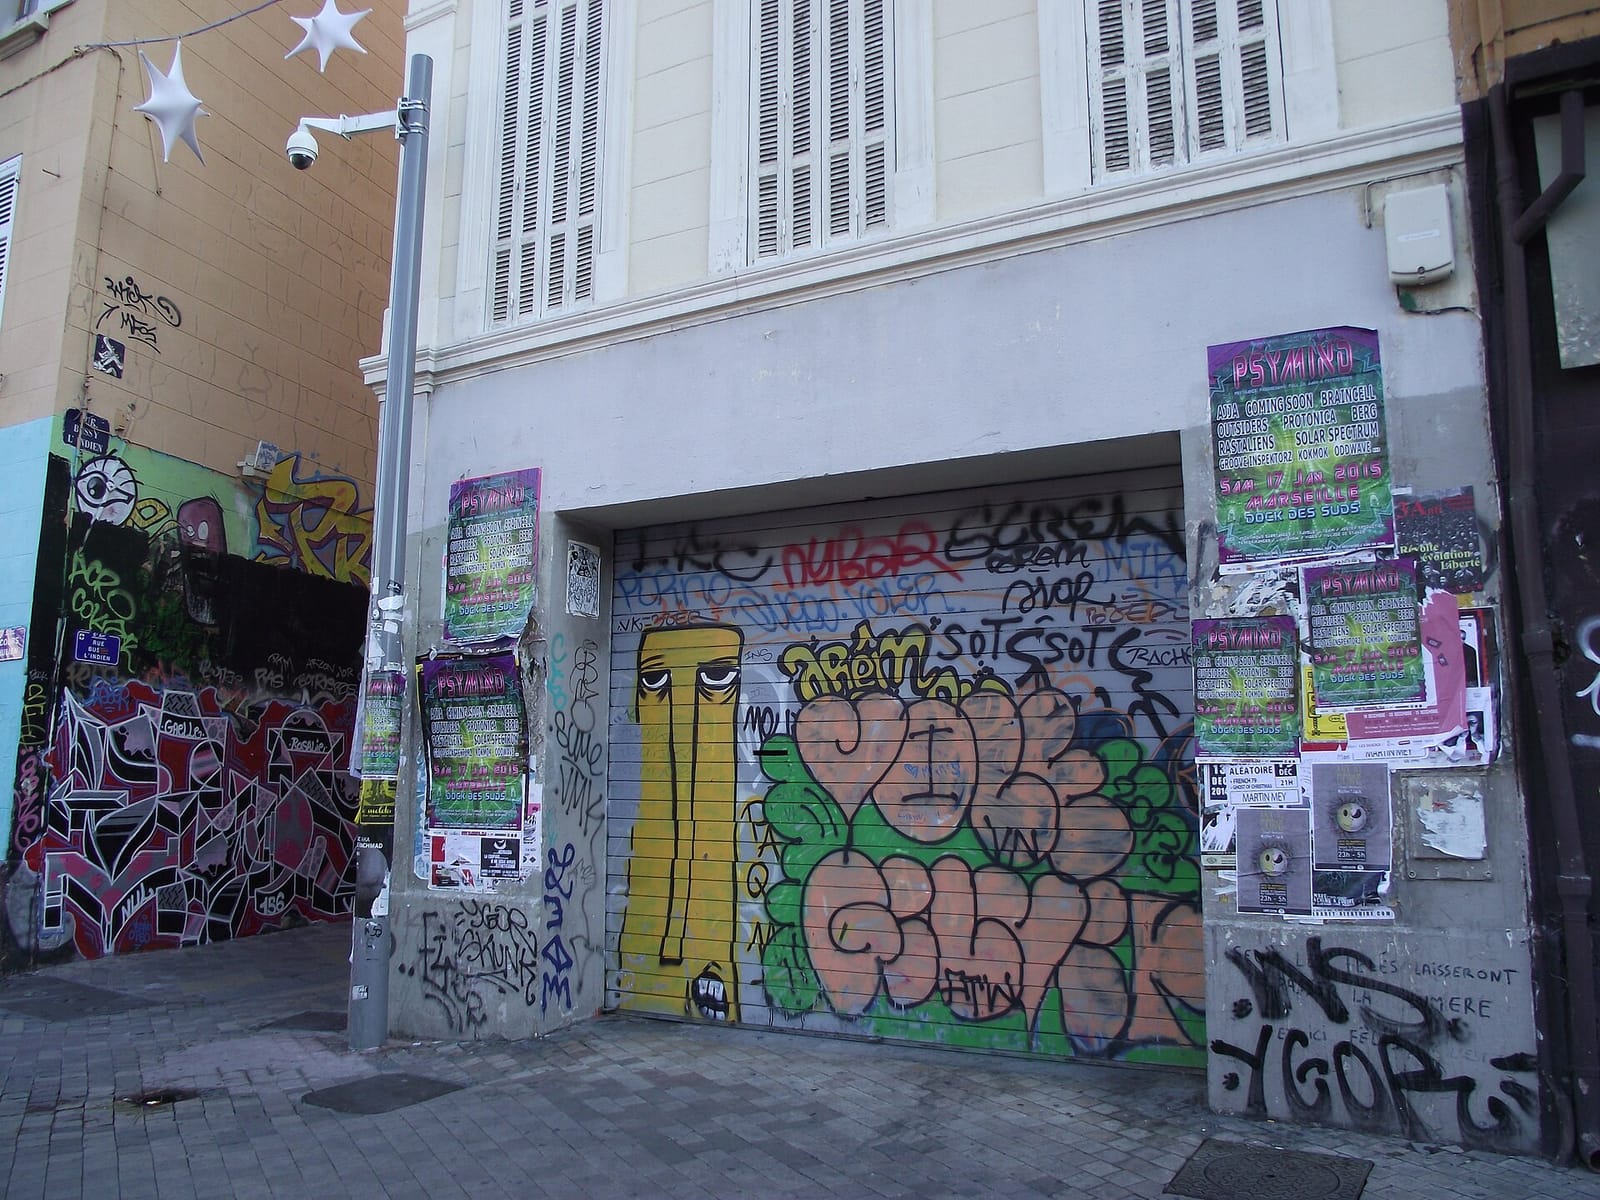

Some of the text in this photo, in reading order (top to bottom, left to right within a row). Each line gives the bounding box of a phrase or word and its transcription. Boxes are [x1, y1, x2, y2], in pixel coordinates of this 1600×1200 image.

[1232, 339, 1353, 390] PSYMIND
[1217, 402, 1239, 421] AJJA
[1321, 384, 1376, 406] BRAINCELL
[73, 423, 99, 439] BSSY
[1217, 403, 1377, 438] OUTSIDERS PROTONICA BERG
[67, 434, 103, 453] L'NDIEN
[1218, 422, 1379, 456] RASTALIENS SOLAR SPECTRUM
[1298, 447, 1329, 461] KOKMOK
[1267, 471, 1285, 489] 17
[1334, 461, 1382, 481] 2015
[1245, 484, 1360, 511] MARSEILLE
[1245, 501, 1361, 524] DOCK DES SUDS
[1242, 791, 1287, 803] MARTIN MEY
